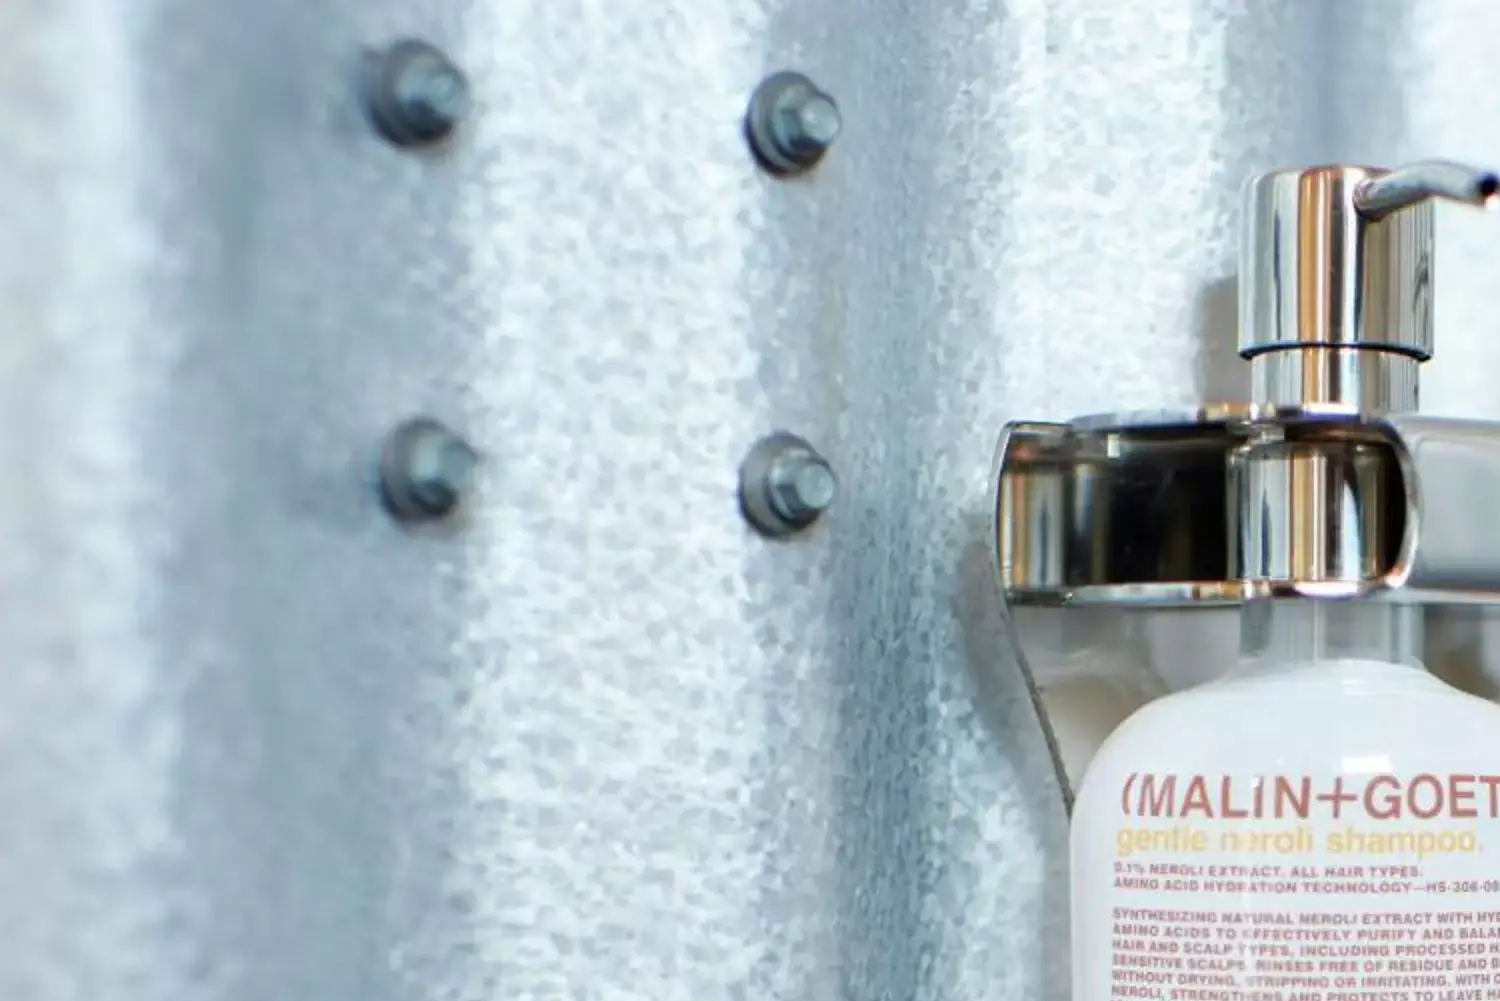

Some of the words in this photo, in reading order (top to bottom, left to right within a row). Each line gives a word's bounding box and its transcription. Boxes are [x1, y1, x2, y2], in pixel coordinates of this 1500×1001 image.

[1116, 827, 1208, 858] gentle
[1149, 862, 1203, 876] NEROLI
[1290, 865, 1319, 877] ALL
[1325, 865, 1363, 877] HAIR
[1368, 865, 1423, 877] TYPES.
[1113, 876, 1159, 890] AMINO
[1163, 879, 1199, 891] ACID
[1203, 880, 1297, 893] HYDRATION
[1112, 907, 1217, 923] SYNTHESIZING
[1221, 911, 1294, 924] NATURAL
[1298, 913, 1357, 924] NEROLI
[1361, 912, 1432, 924] EXTRACT
[1436, 912, 1472, 923] WITH
[1112, 922, 1159, 936] AMINO
[1163, 925, 1210, 938] ACIDS
[1215, 927, 1236, 939] TO
[1357, 928, 1416, 940] PURIFY
[1423, 927, 1453, 939] AND
[1111, 938, 1145, 951] HAIR
[1149, 940, 1179, 953] AND
[1183, 941, 1232, 955] SCALP
[1299, 944, 1389, 956] INCLUDING
[1395, 942, 1485, 955] PROCESSED
[1112, 953, 1182, 968] SENSITIVE
[1254, 959, 1314, 972] RINSES
[1319, 960, 1359, 972] FREE
[1363, 960, 1384, 971] OF
[1388, 959, 1453, 971] RESIDUE
[1457, 958, 1487, 970] AND
[1112, 969, 1173, 983] WITHOUT
[1245, 975, 1330, 987] STRIPPING
[1333, 976, 1357, 987] OR
[1456, 973, 1490, 986] WITH
[1413, 990, 1433, 1001] TO
[1438, 989, 1482, 1001] LEAVE
